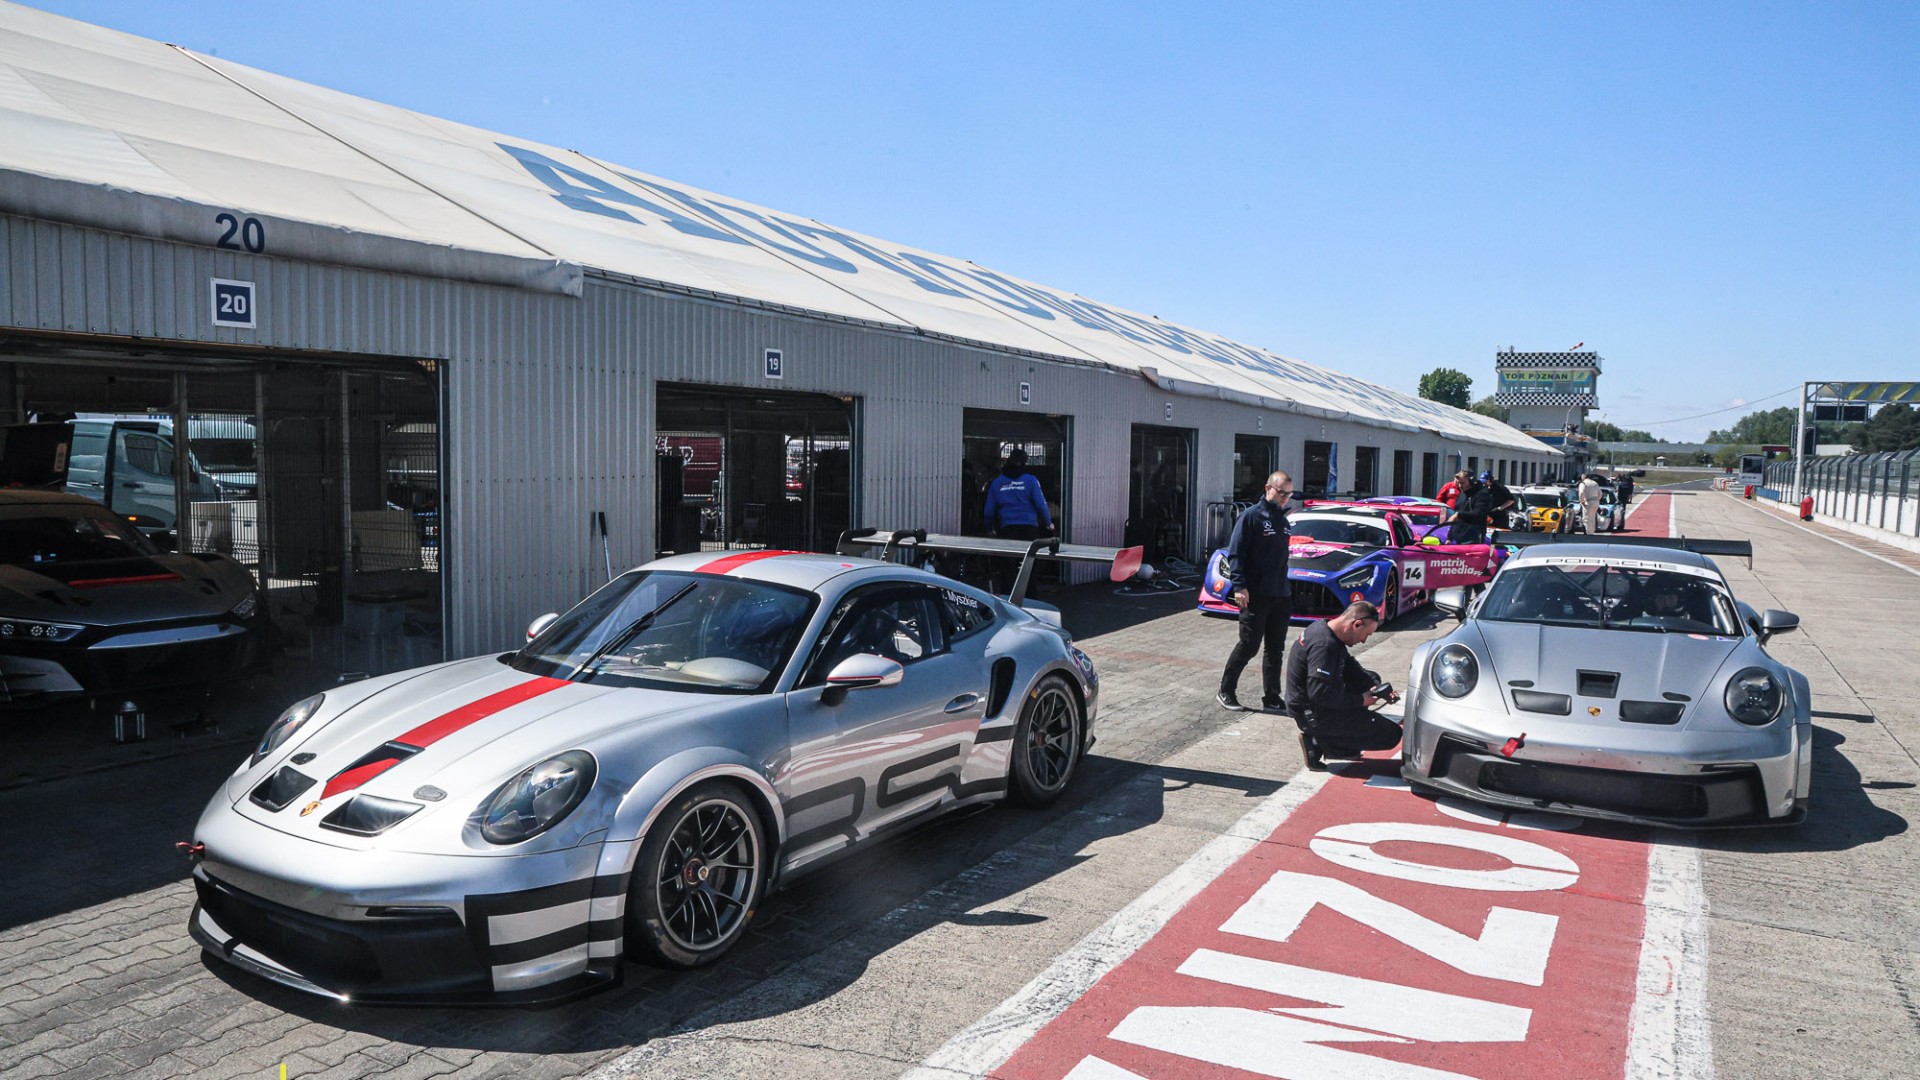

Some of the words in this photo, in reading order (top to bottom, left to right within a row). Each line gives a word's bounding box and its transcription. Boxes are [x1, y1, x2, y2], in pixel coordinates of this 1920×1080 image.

[215, 212, 265, 253] 20
[220, 293, 247, 314] 20
[768, 357, 779, 370] 19
[1430, 557, 1466, 567] matrix
[1546, 558, 1677, 571] PORSCHE
[1404, 567, 1422, 580] 14
[1440, 565, 1474, 575] media
